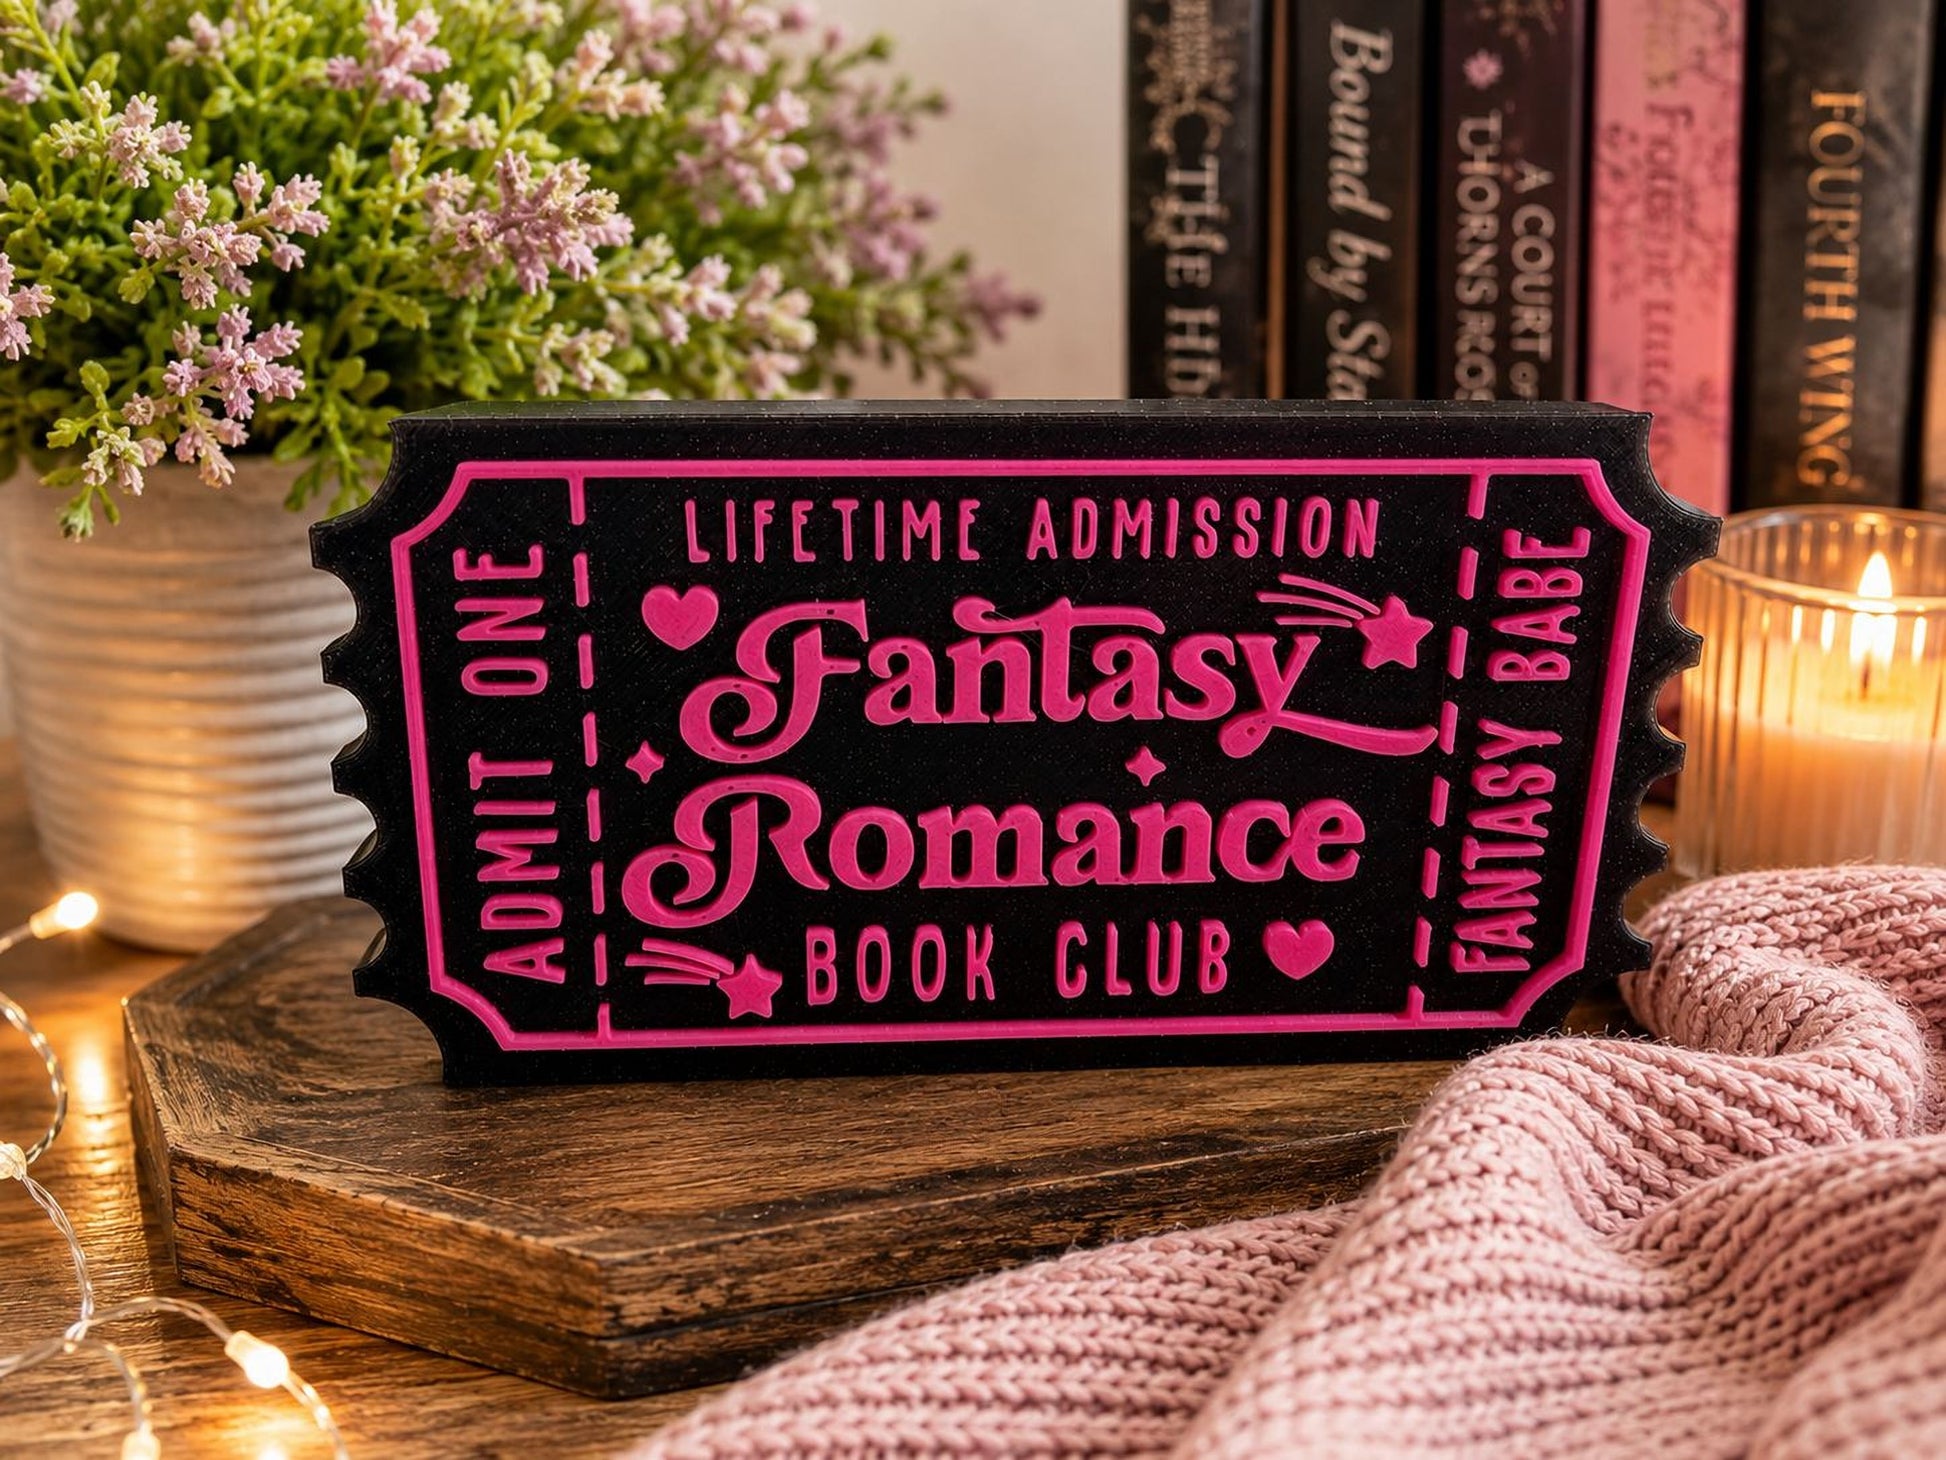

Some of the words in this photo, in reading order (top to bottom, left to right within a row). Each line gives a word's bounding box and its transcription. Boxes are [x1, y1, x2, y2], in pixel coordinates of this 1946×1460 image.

[1328, 20, 1393, 221] Bound
[1514, 160, 1555, 193] A
[1306, 229, 1392, 303] by
[1456, 110, 1501, 305] THORNS
[1511, 204, 1555, 362] COURT
[1803, 90, 1867, 322] FOURTH
[1797, 334, 1856, 488] WING
[685, 499, 980, 562] LIFETIME
[1027, 497, 1379, 559] ADMISSION
[1488, 527, 1591, 681] BABE
[453, 545, 548, 696] ONE
[680, 594, 1438, 763] Fantasy
[468, 752, 565, 983] ADMIT
[622, 775, 1365, 928] Romance
[1452, 719, 1562, 972] FANTASY
[806, 925, 994, 1005] BOOK
[1057, 920, 1230, 998] CLUB
